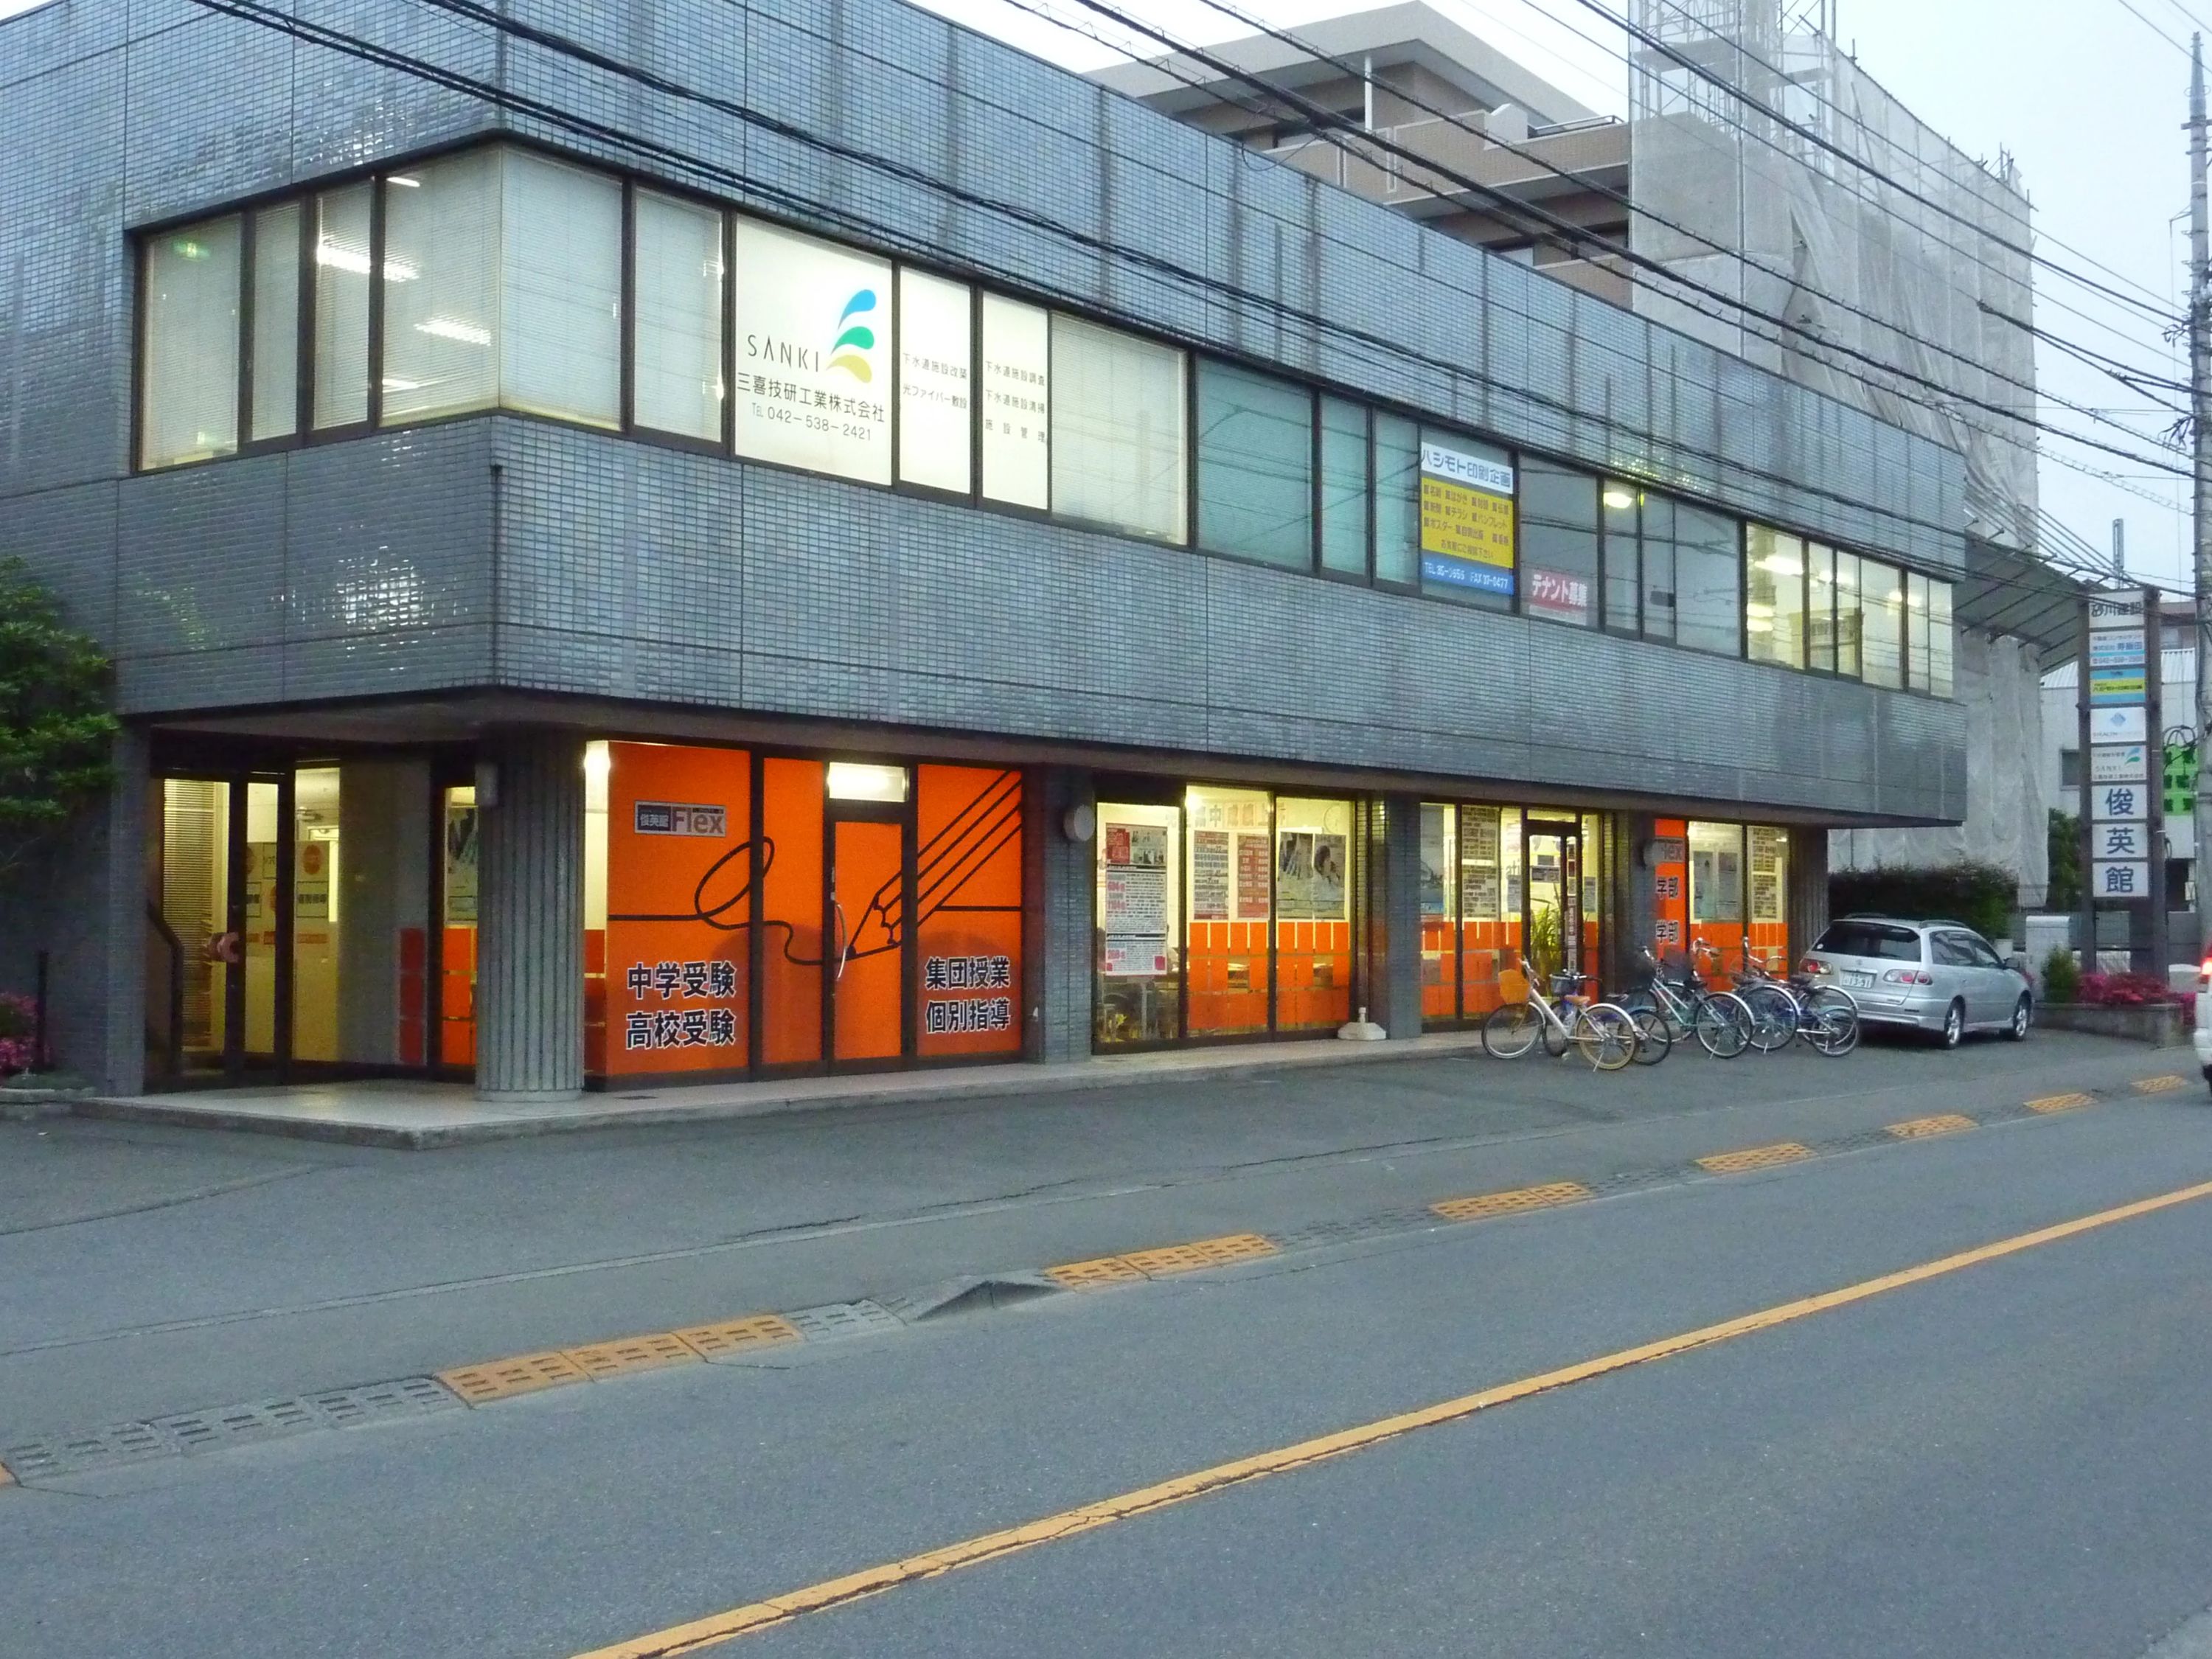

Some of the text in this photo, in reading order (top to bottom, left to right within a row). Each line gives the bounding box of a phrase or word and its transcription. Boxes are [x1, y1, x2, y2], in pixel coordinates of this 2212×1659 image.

[748, 334, 818, 372] SANKI
[737, 372, 885, 423] 三喜技研工業株式会社
[768, 406, 871, 441] 042-538-2421
[1422, 449, 1511, 488] ハシモト印刷企画
[1425, 562, 1436, 574] TEL
[1470, 571, 1482, 584] FAX
[1532, 574, 1587, 607] テナント募集
[672, 807, 723, 834] Flex
[627, 960, 737, 1000] 中学受験
[925, 956, 1011, 991] 集団授業
[626, 1008, 737, 1050] 高校受験
[925, 997, 1011, 1034] 個別指導
